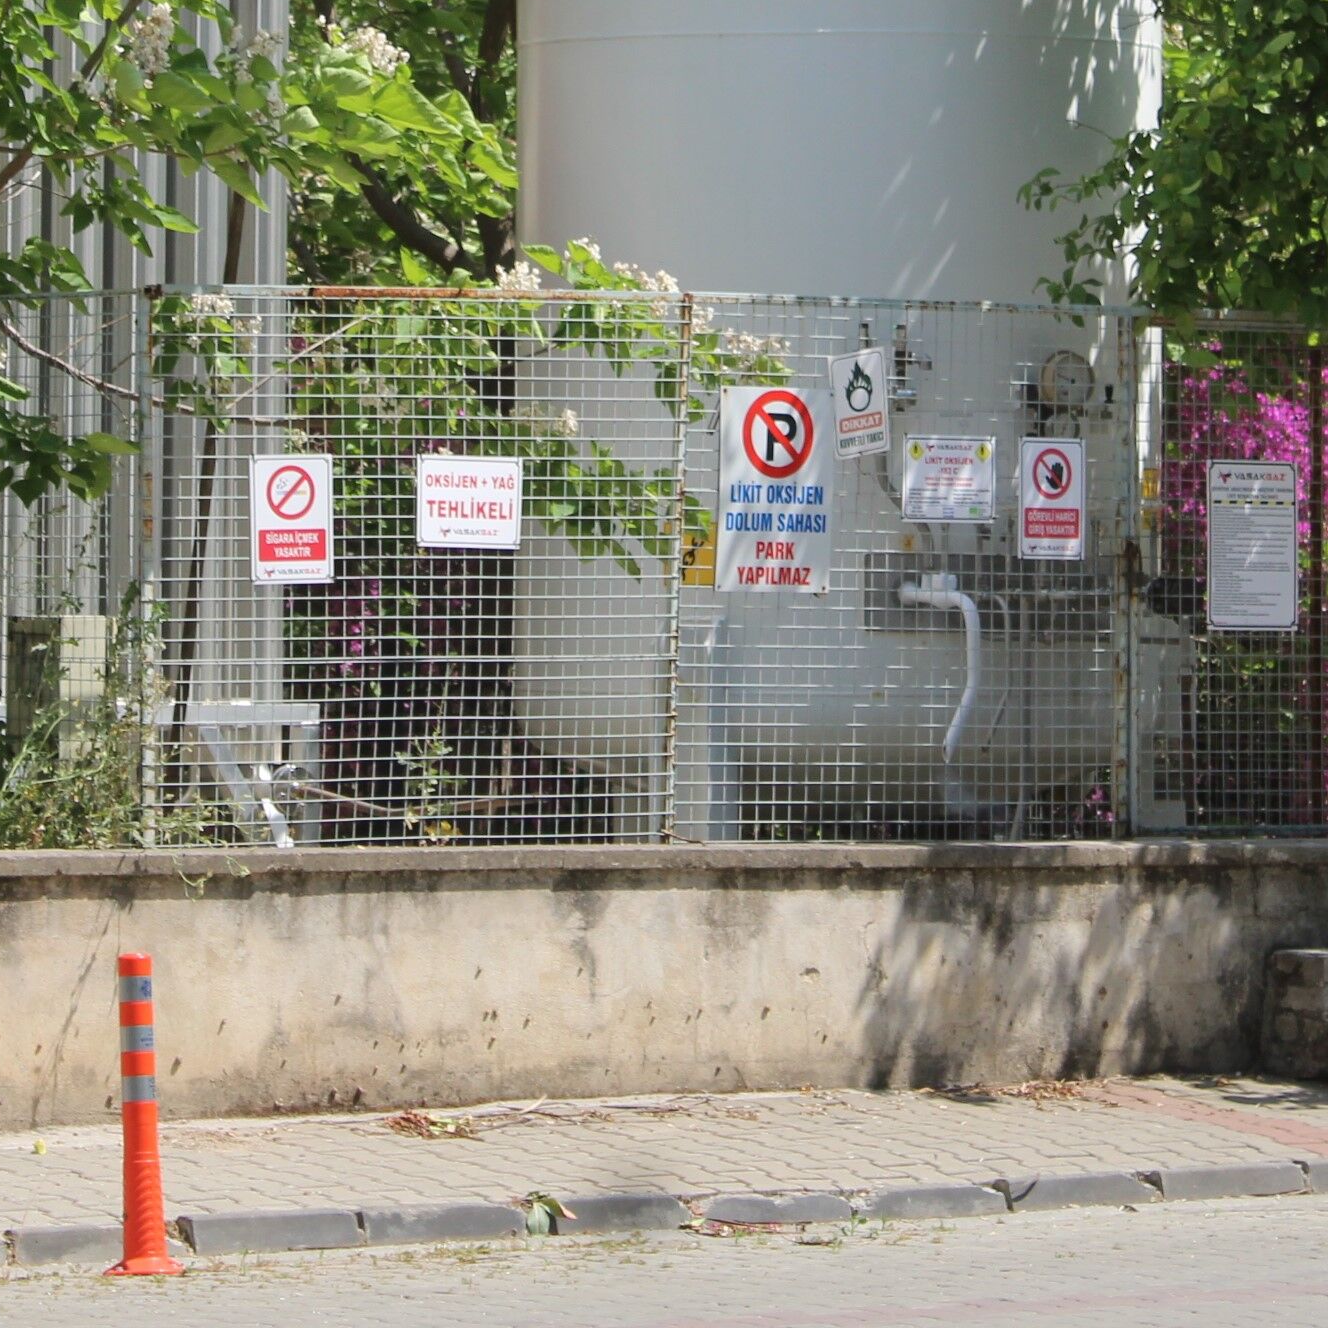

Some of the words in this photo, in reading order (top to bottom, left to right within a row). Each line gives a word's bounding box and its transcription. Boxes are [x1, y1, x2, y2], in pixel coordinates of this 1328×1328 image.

[841, 414, 881, 432] DİKKAT
[425, 472, 478, 489] OKSİJEN
[491, 473, 515, 490] YAĞ
[730, 480, 763, 504] LİKİT
[767, 481, 824, 505] OKSİJEN
[426, 496, 514, 520] TEHLİKELİ
[725, 512, 772, 532] DOLUM
[777, 513, 827, 533] SAHASI
[265, 531, 294, 545] SİGARA
[295, 531, 319, 547] İÇMEK
[274, 547, 311, 558] YASAKTIR
[755, 541, 795, 560] PARK
[737, 566, 811, 585] YAPILMAZ
